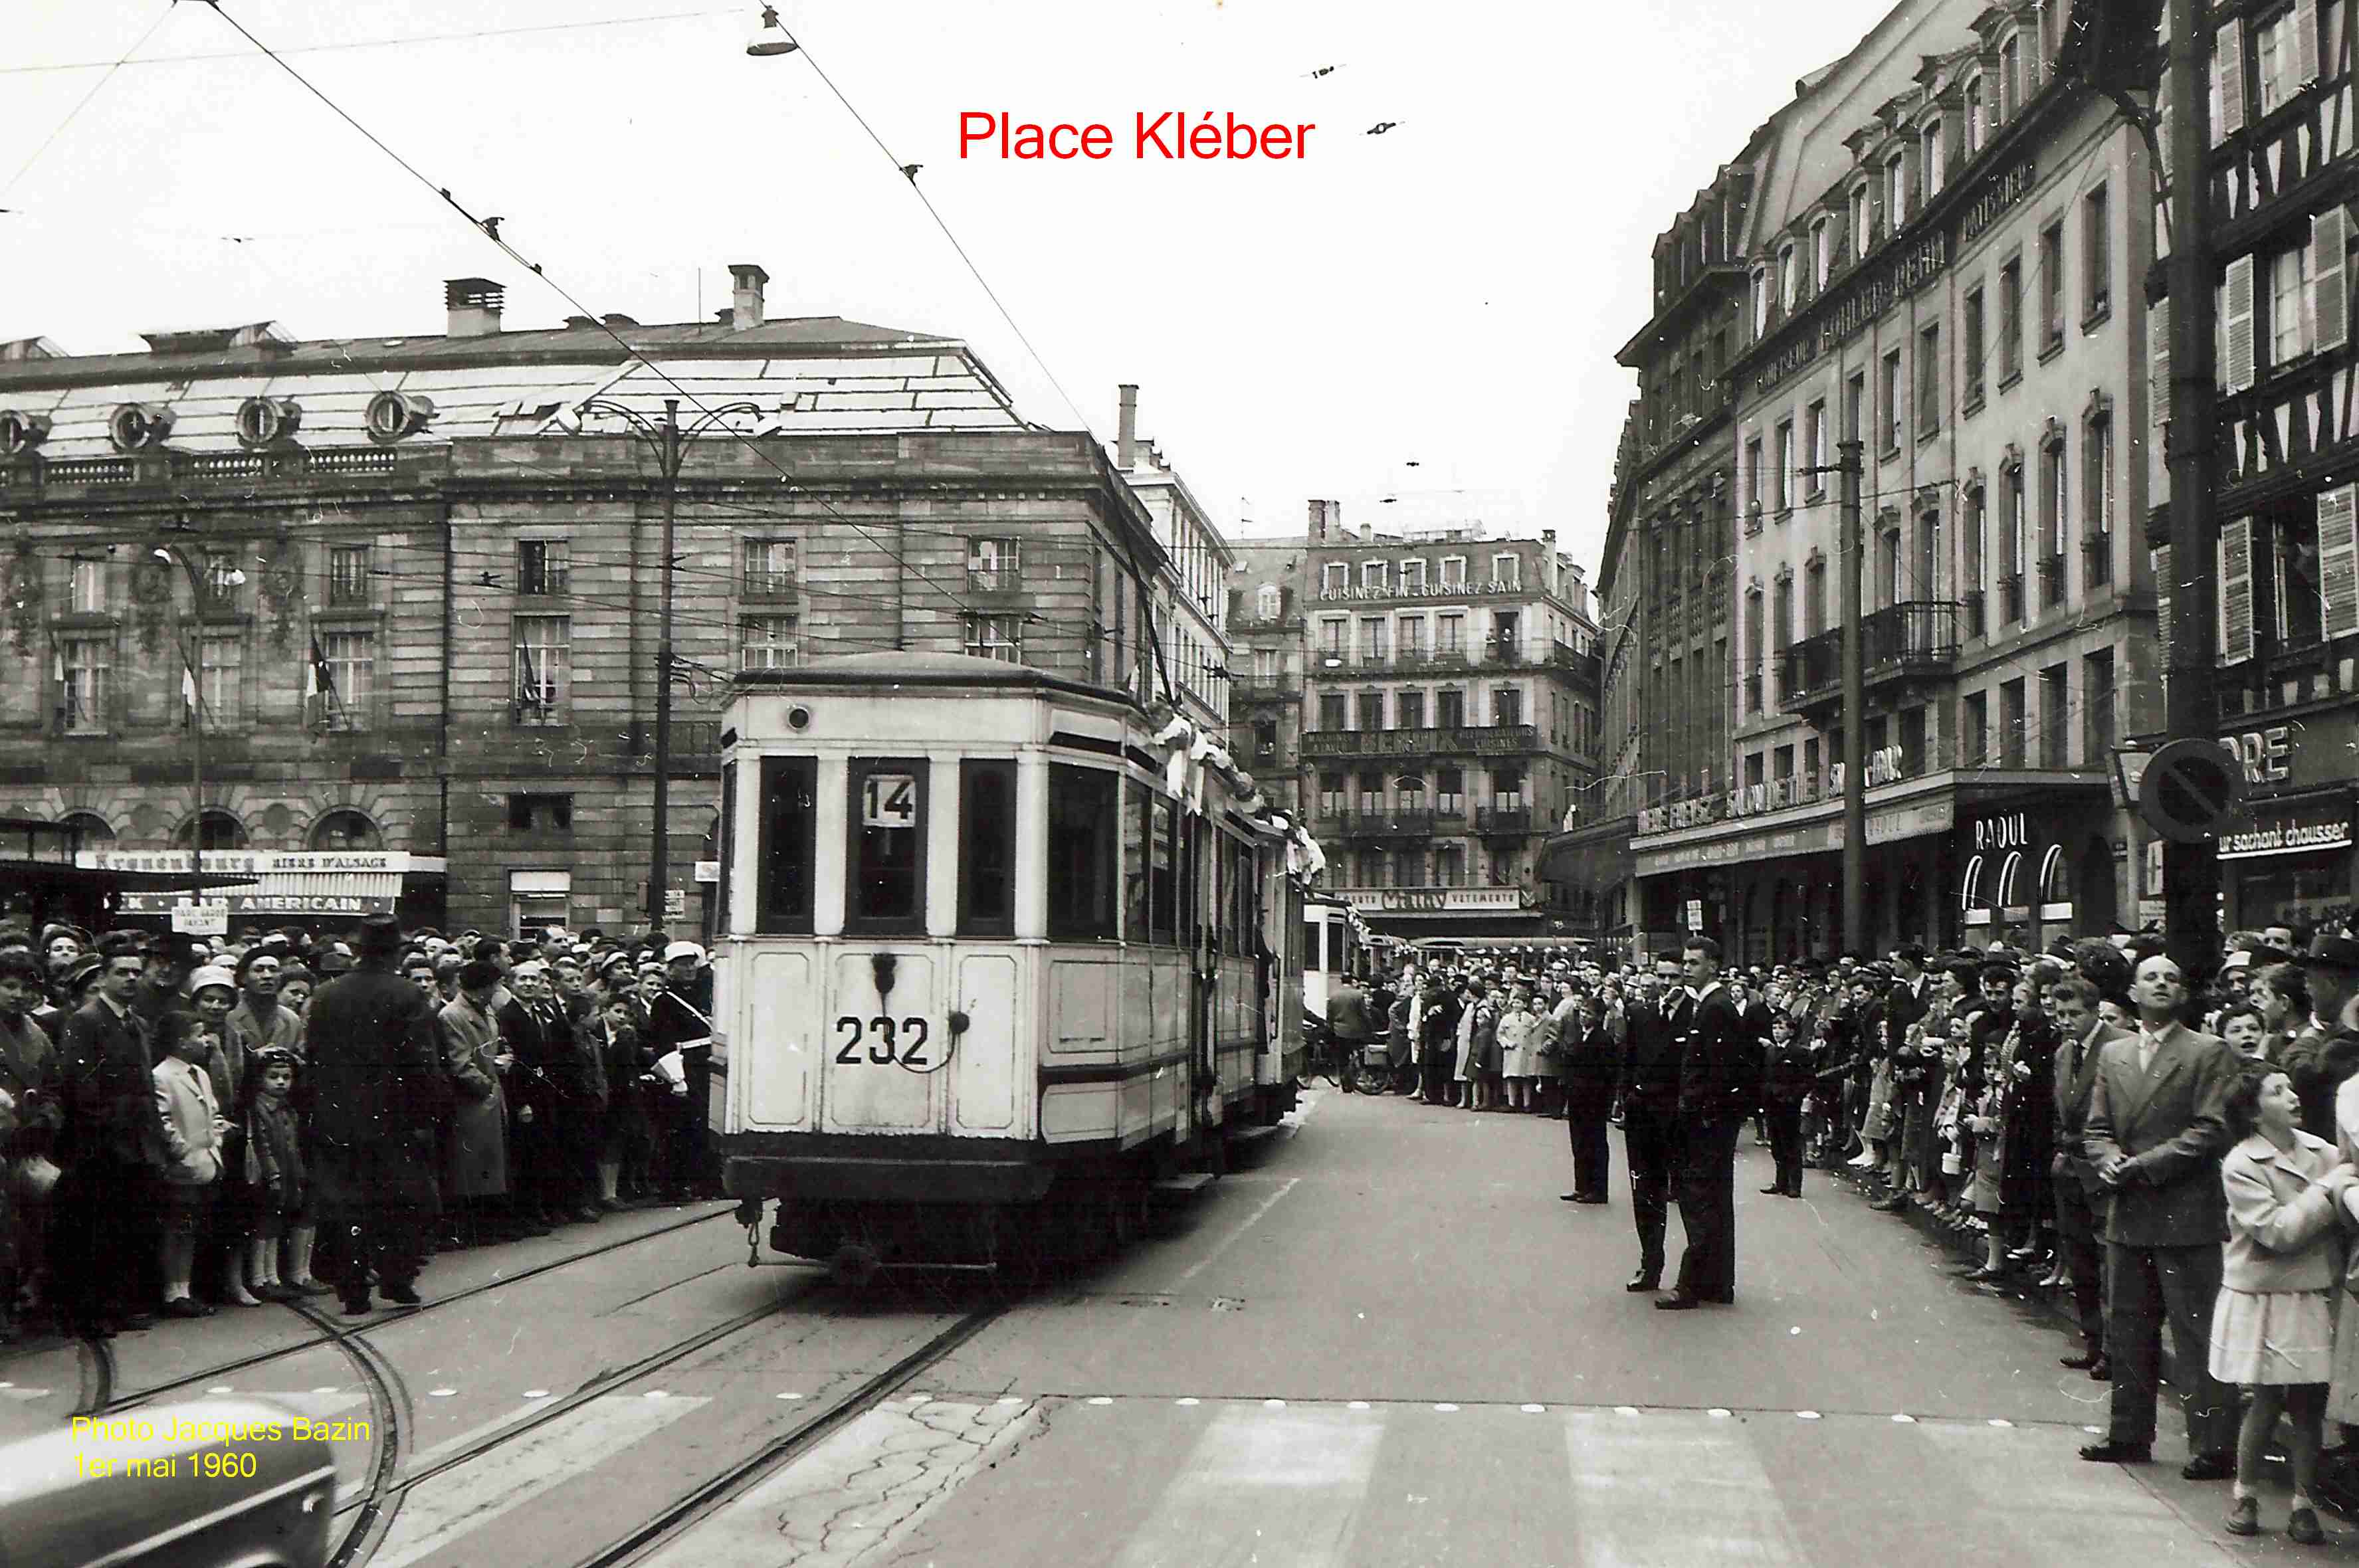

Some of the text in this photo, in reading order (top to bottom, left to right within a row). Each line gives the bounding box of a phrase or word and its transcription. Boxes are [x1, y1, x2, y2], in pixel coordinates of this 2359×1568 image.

[1320, 585, 1380, 601] CUISINEZ
[1421, 581, 1482, 597] CUISINEZ
[1487, 579, 1522, 595] SAIN
[866, 780, 912, 820] 14
[1976, 813, 2028, 850] RAOUL
[2233, 818, 2283, 851] sachant
[2285, 819, 2349, 846] chausser
[240, 897, 361, 910] AMERICAIN
[835, 1016, 928, 1065] 232
